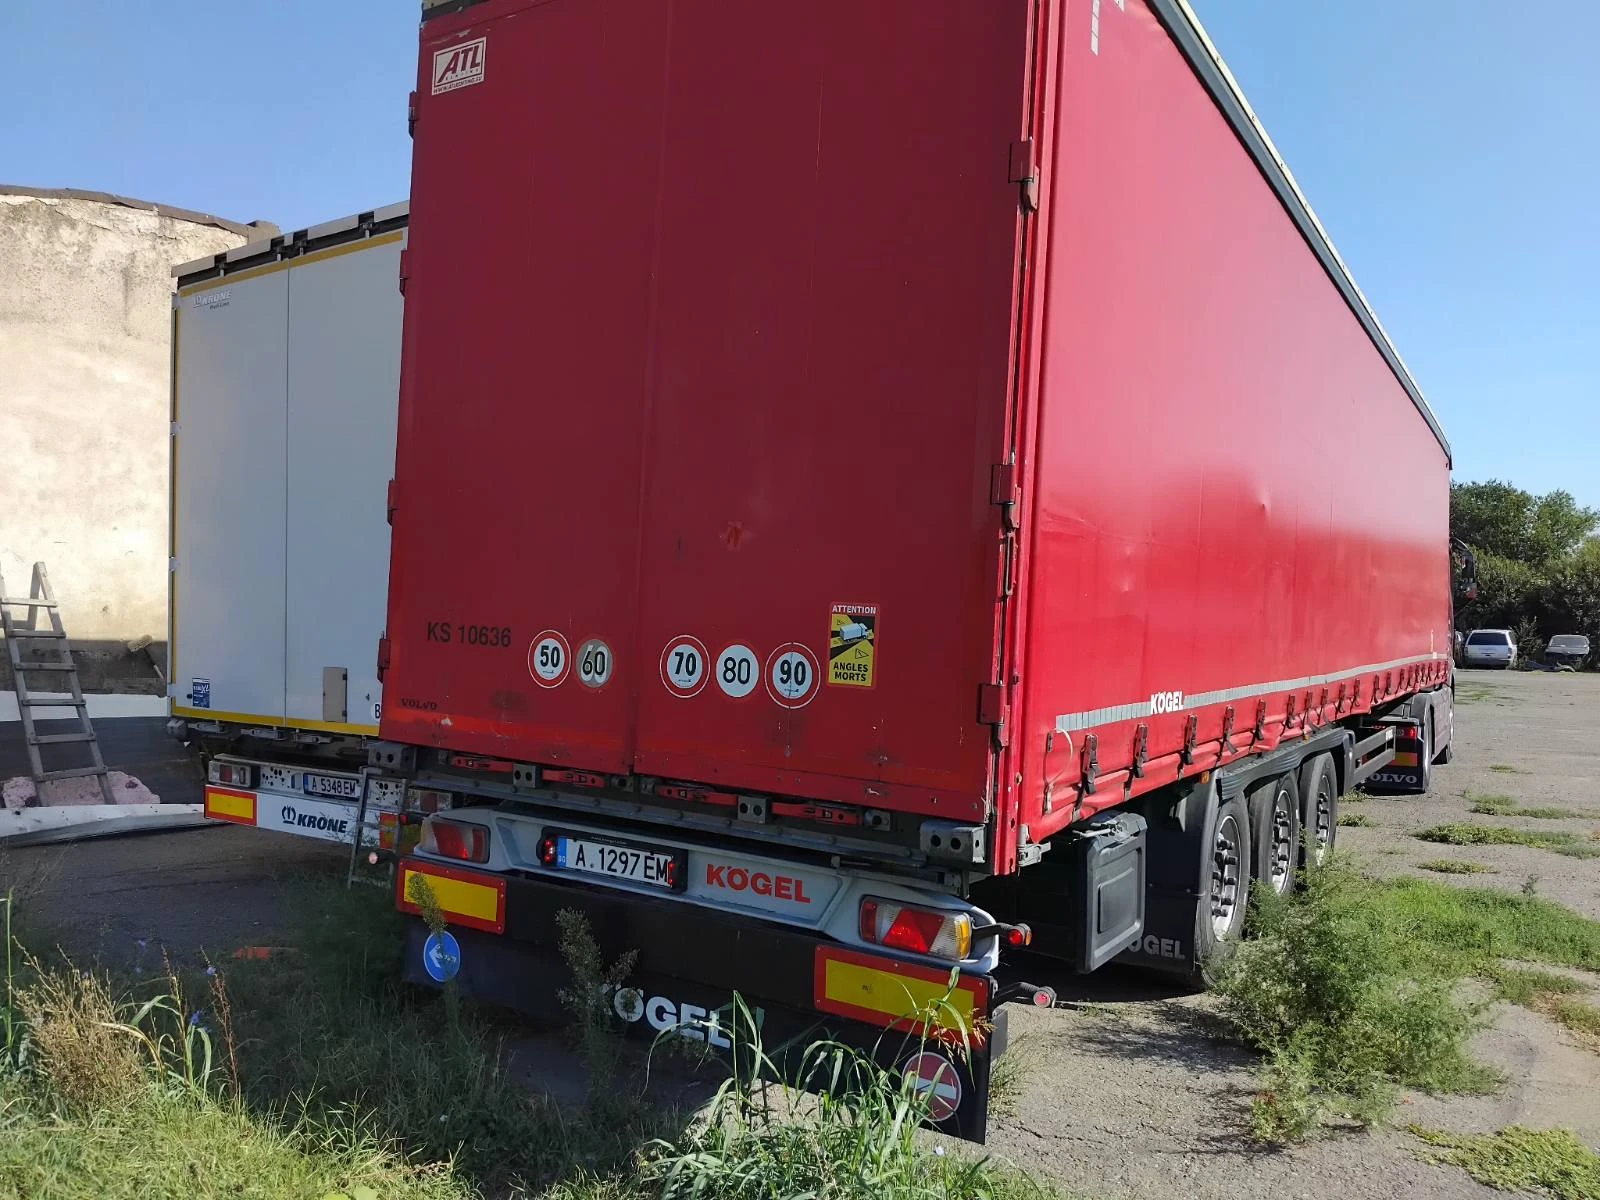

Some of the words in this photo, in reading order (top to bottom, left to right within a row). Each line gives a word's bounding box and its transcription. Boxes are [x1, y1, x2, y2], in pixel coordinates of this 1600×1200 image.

[437, 45, 480, 83] ATL
[832, 605, 877, 615] ATTENTION
[427, 621, 452, 643] KS
[458, 624, 512, 648] 10636
[540, 645, 561, 668] 50
[582, 648, 606, 676] 60
[674, 651, 697, 677] 70
[833, 662, 869, 673] ANGLES
[722, 656, 751, 685] 80
[779, 659, 806, 687] 90
[834, 671, 867, 682] MORTS
[401, 698, 438, 711] VOLVO
[1150, 690, 1184, 715] KÖGEL
[312, 777, 317, 791] A
[1370, 773, 1418, 784] OLVO
[297, 813, 348, 834] KRONE
[575, 844, 586, 867] A
[706, 863, 811, 904] KÖGEL
[1127, 934, 1186, 960] GEL
